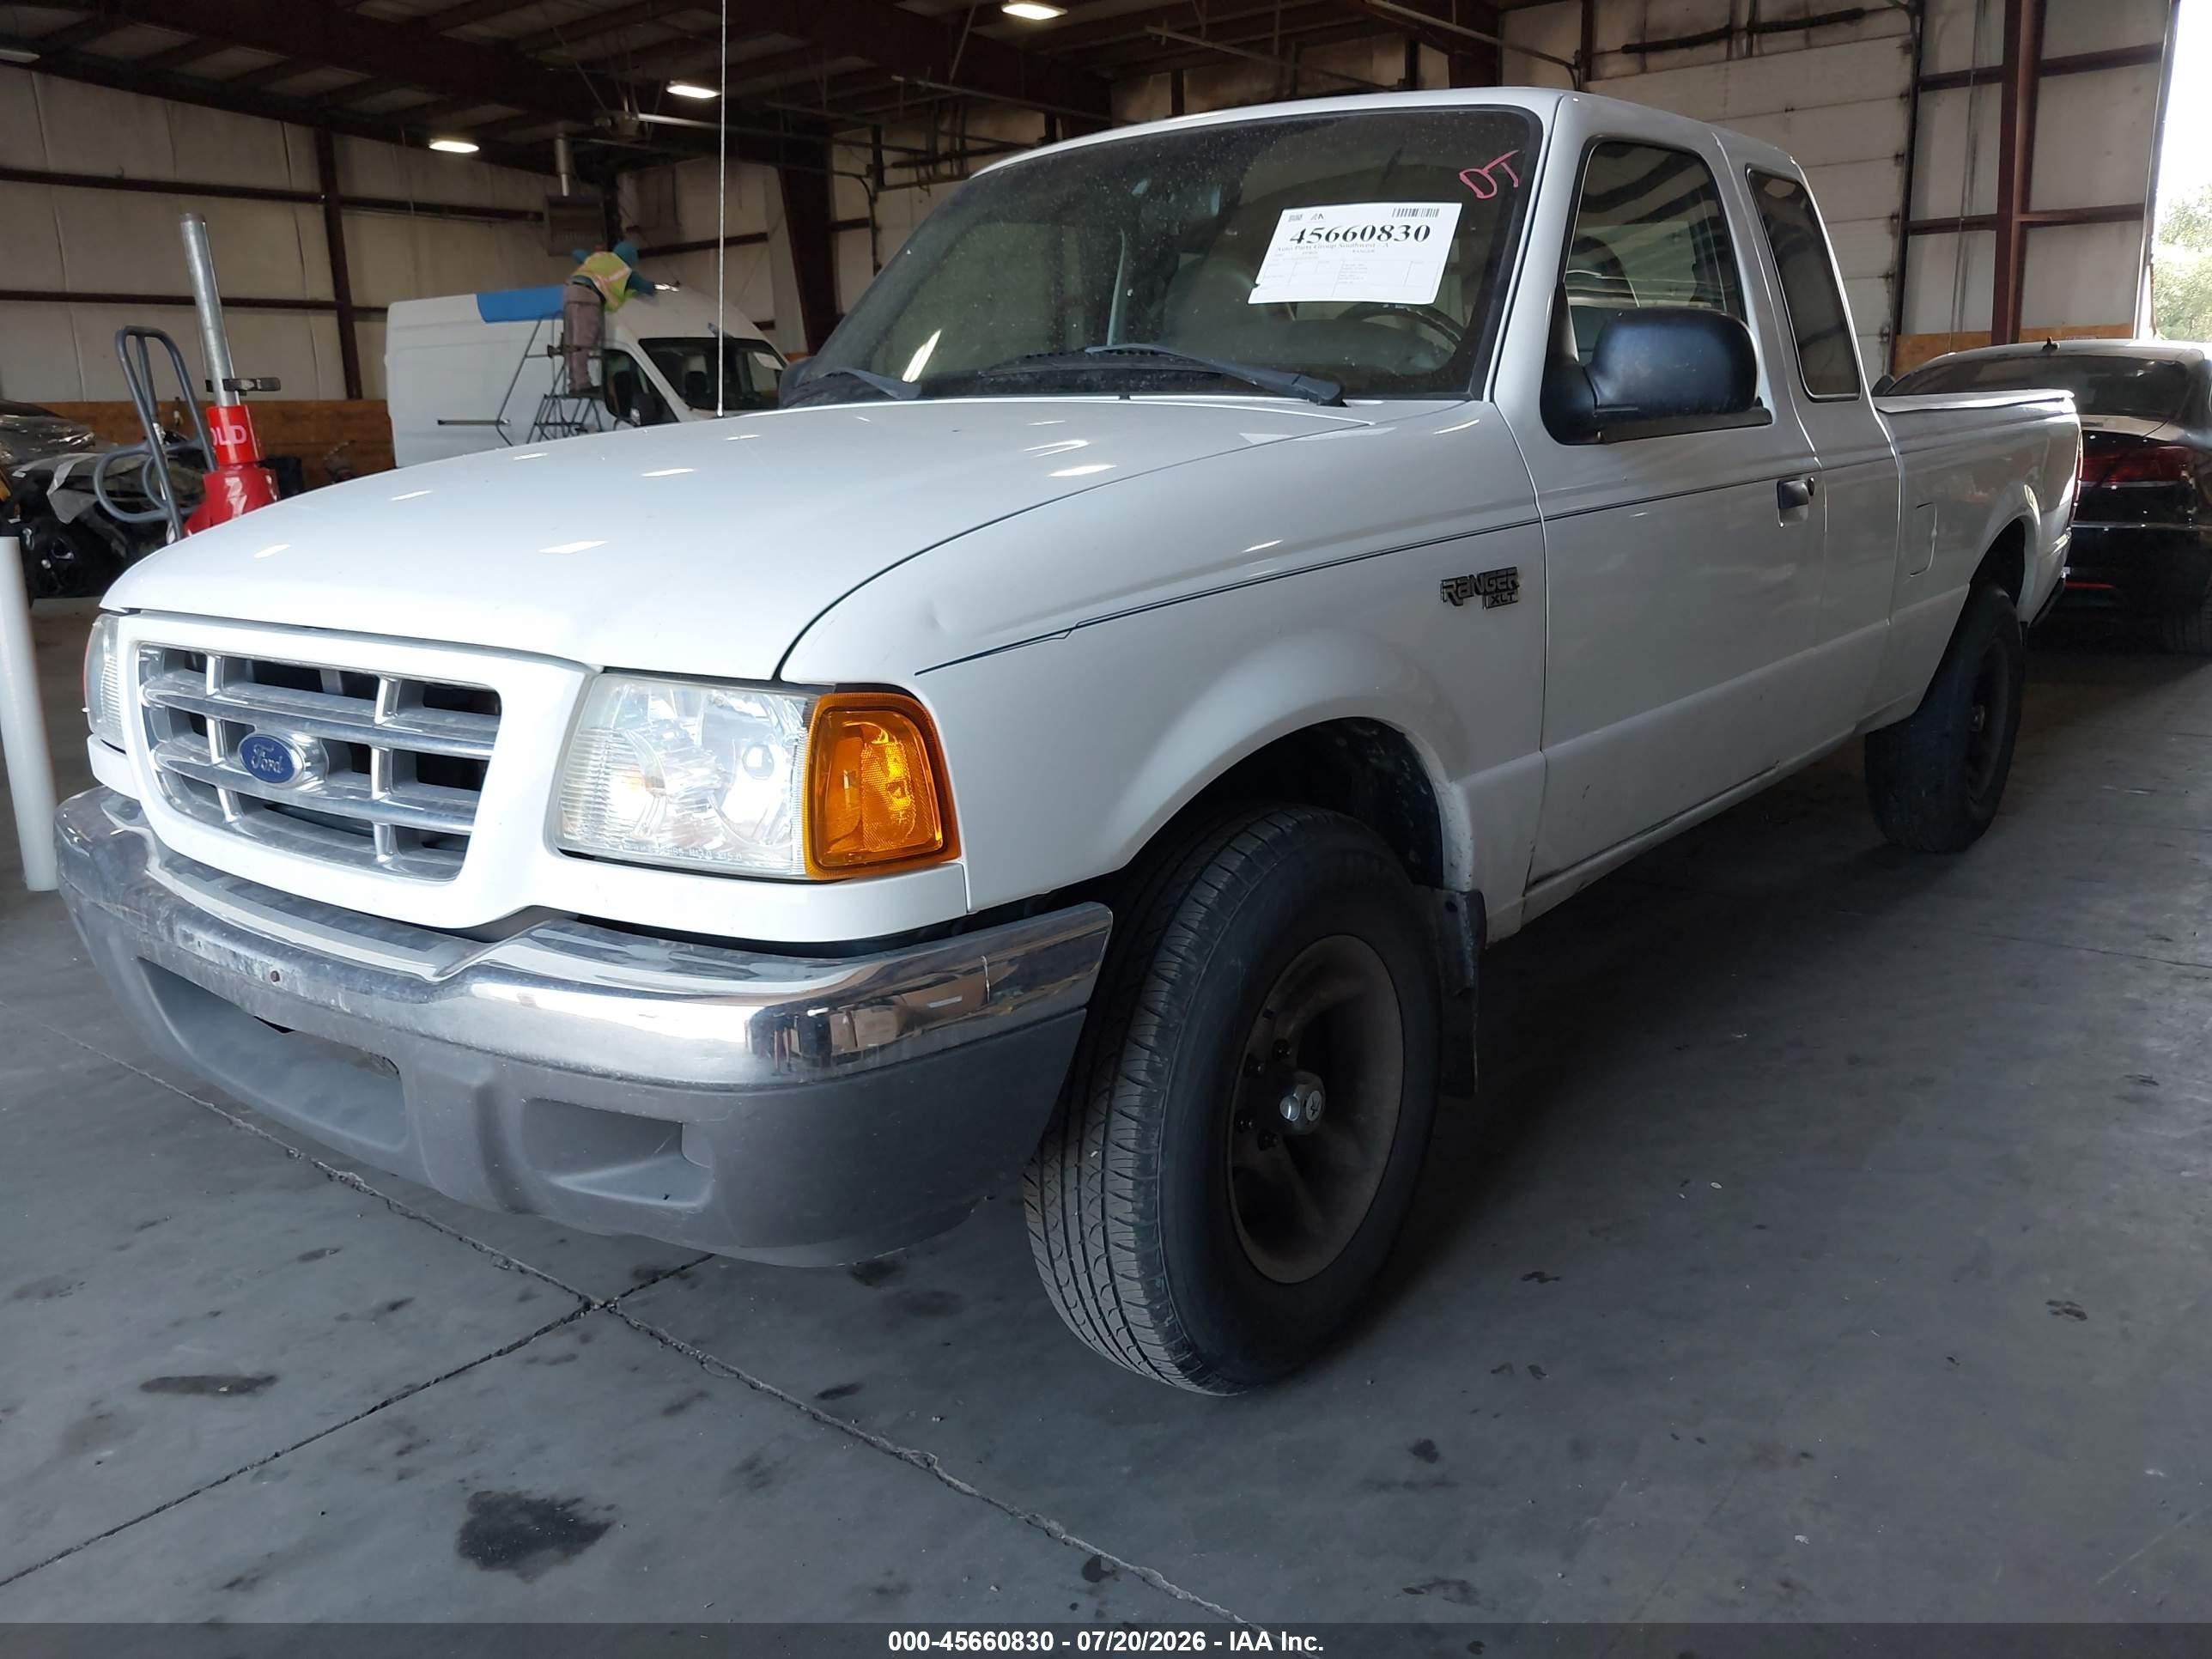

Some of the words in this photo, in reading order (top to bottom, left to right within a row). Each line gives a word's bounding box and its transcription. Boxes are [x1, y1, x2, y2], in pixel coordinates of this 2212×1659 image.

[1289, 224, 1431, 244] 45660830
[1440, 567, 1519, 606] RANGER
[1490, 591, 1516, 606] XLT
[251, 744, 284, 774] Ford
